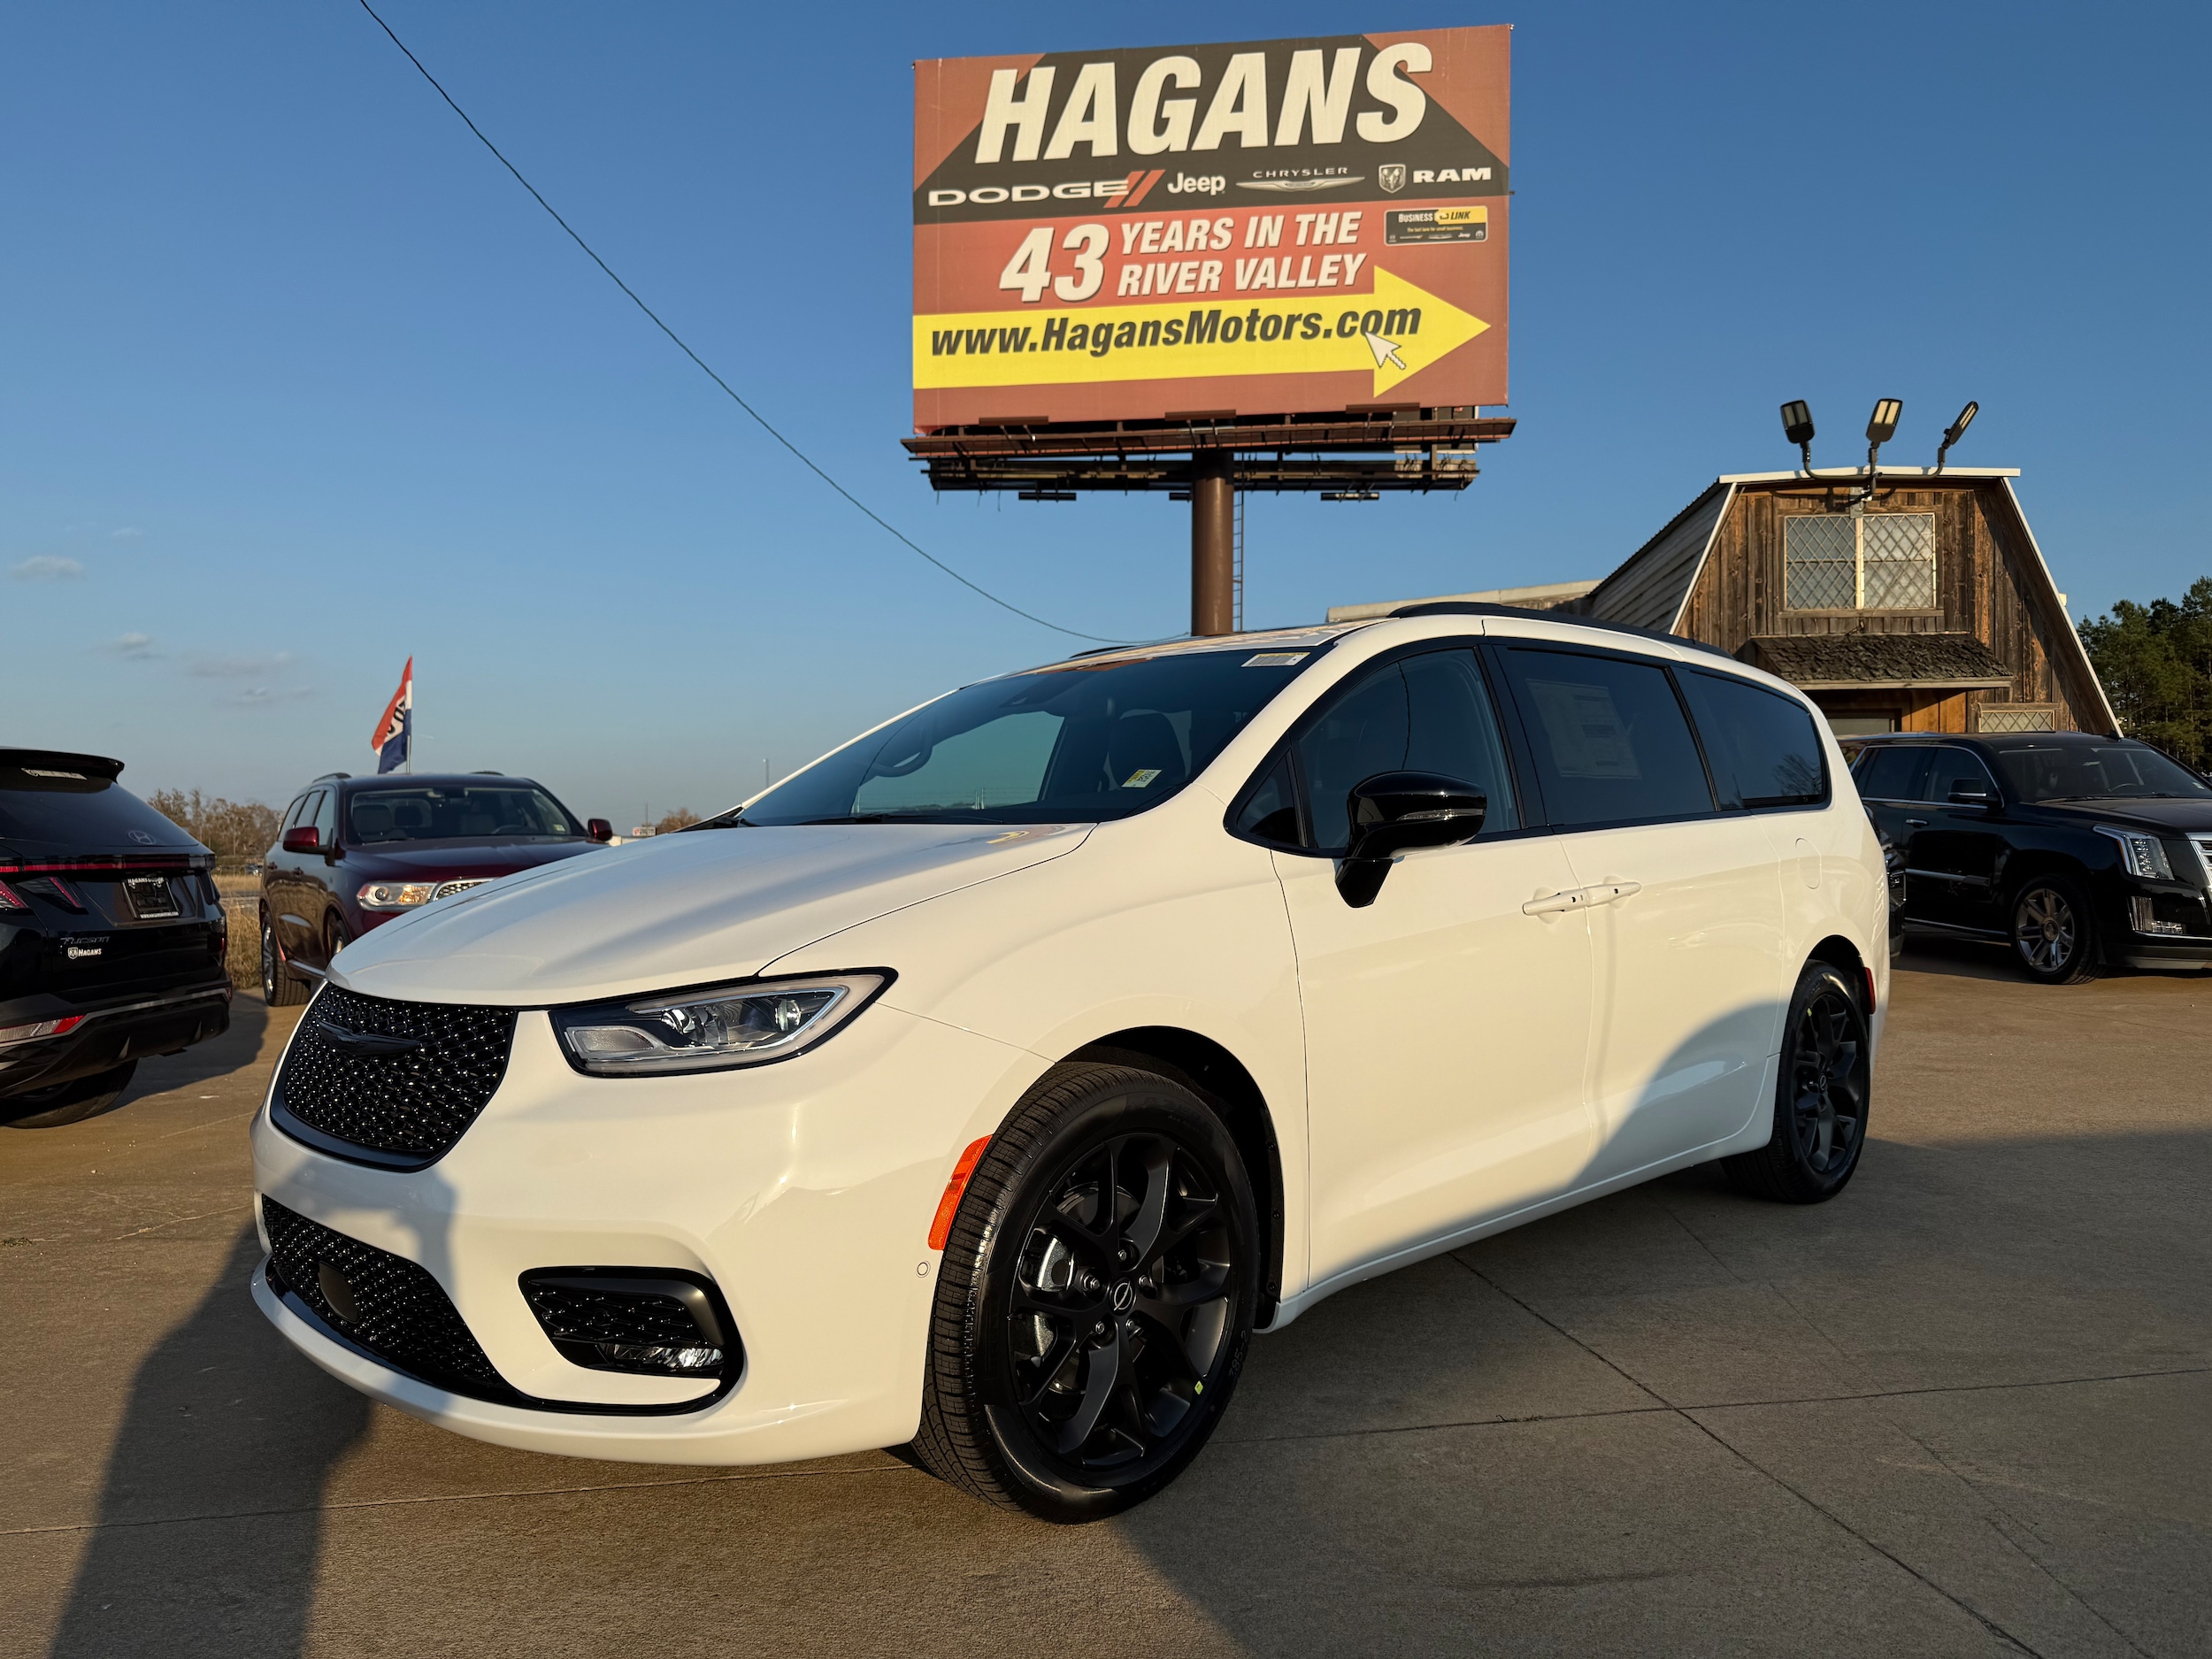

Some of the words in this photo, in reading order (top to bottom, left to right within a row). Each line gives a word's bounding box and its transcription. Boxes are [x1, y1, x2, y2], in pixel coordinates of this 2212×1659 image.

[975, 42, 1432, 165] HAGANS
[1167, 173, 1226, 196] Jeep
[1252, 166, 1348, 179] CHRYSLER
[1413, 166, 1492, 184] RAM
[928, 179, 1130, 207] DODGE
[1398, 212, 1433, 223] BUSINESS
[1450, 211, 1471, 220] LINK
[1120, 216, 1235, 255] YEARS
[1244, 214, 1286, 250] IN
[1294, 211, 1363, 247] THE
[998, 223, 1110, 303] 43
[1117, 259, 1224, 297] RIVER
[1234, 253, 1368, 291] VALLEY
[932, 307, 1422, 357] www.HagansMotors.com
[78, 948, 103, 957] HAGANS
